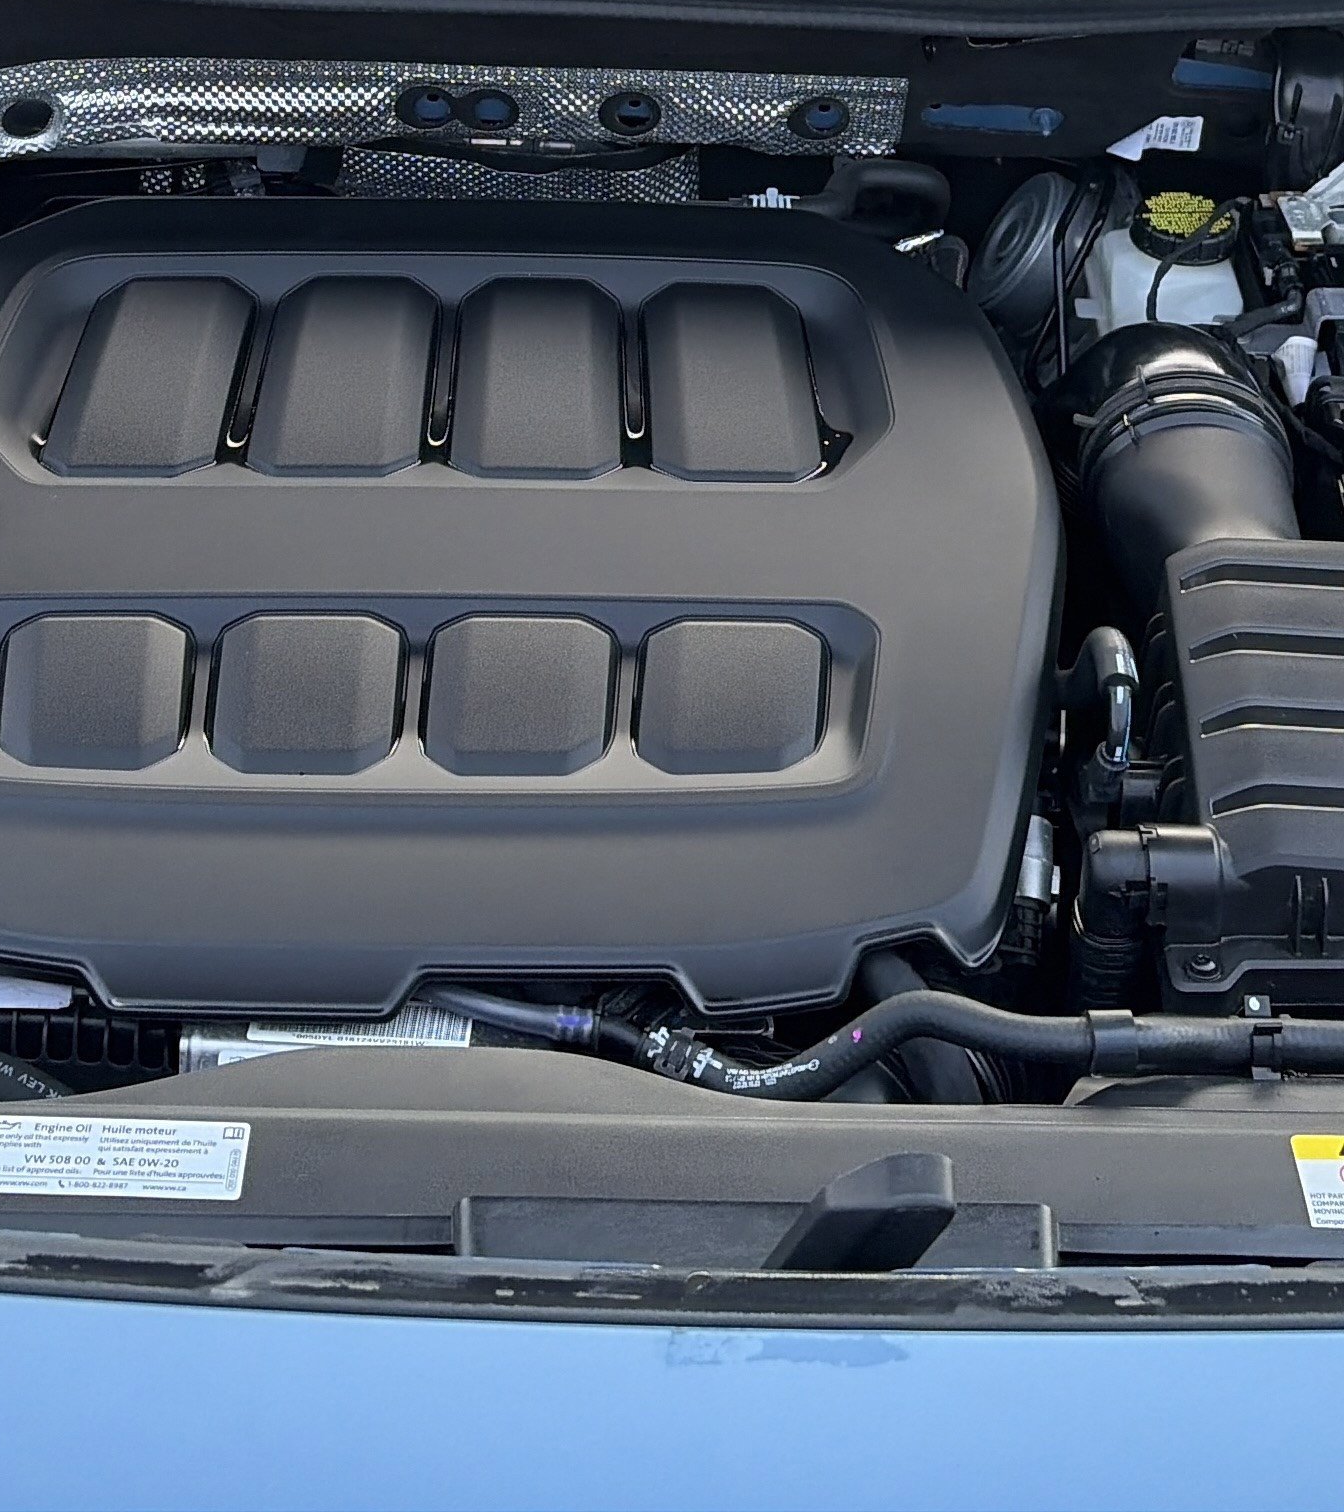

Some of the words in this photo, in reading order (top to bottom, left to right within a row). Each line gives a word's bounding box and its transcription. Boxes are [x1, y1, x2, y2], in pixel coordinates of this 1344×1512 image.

[17, 1072, 47, 1094] LEV
[34, 1123, 73, 1134] Engine
[75, 1123, 93, 1133] Oil
[102, 1125, 132, 1134] Huile
[135, 1127, 178, 1136] moteur
[35, 1133, 52, 1141] that
[52, 1135, 90, 1143] expressly
[100, 1137, 129, 1145] Utilisez
[131, 1139, 180, 1147] uniquement
[113, 1145, 144, 1153] satisfait
[24, 1154, 47, 1164] VW
[48, 1155, 72, 1165] 508
[74, 1155, 92, 1165] 00
[96, 1157, 106, 1166] &
[113, 1157, 135, 1167] SAE
[138, 1158, 179, 1168] 0W-20
[2, 1165, 15, 1173] list
[16, 1165, 25, 1173] of
[25, 1166, 64, 1175] approved
[93, 1168, 112, 1176] Pour
[129, 1169, 145, 1177] liste
